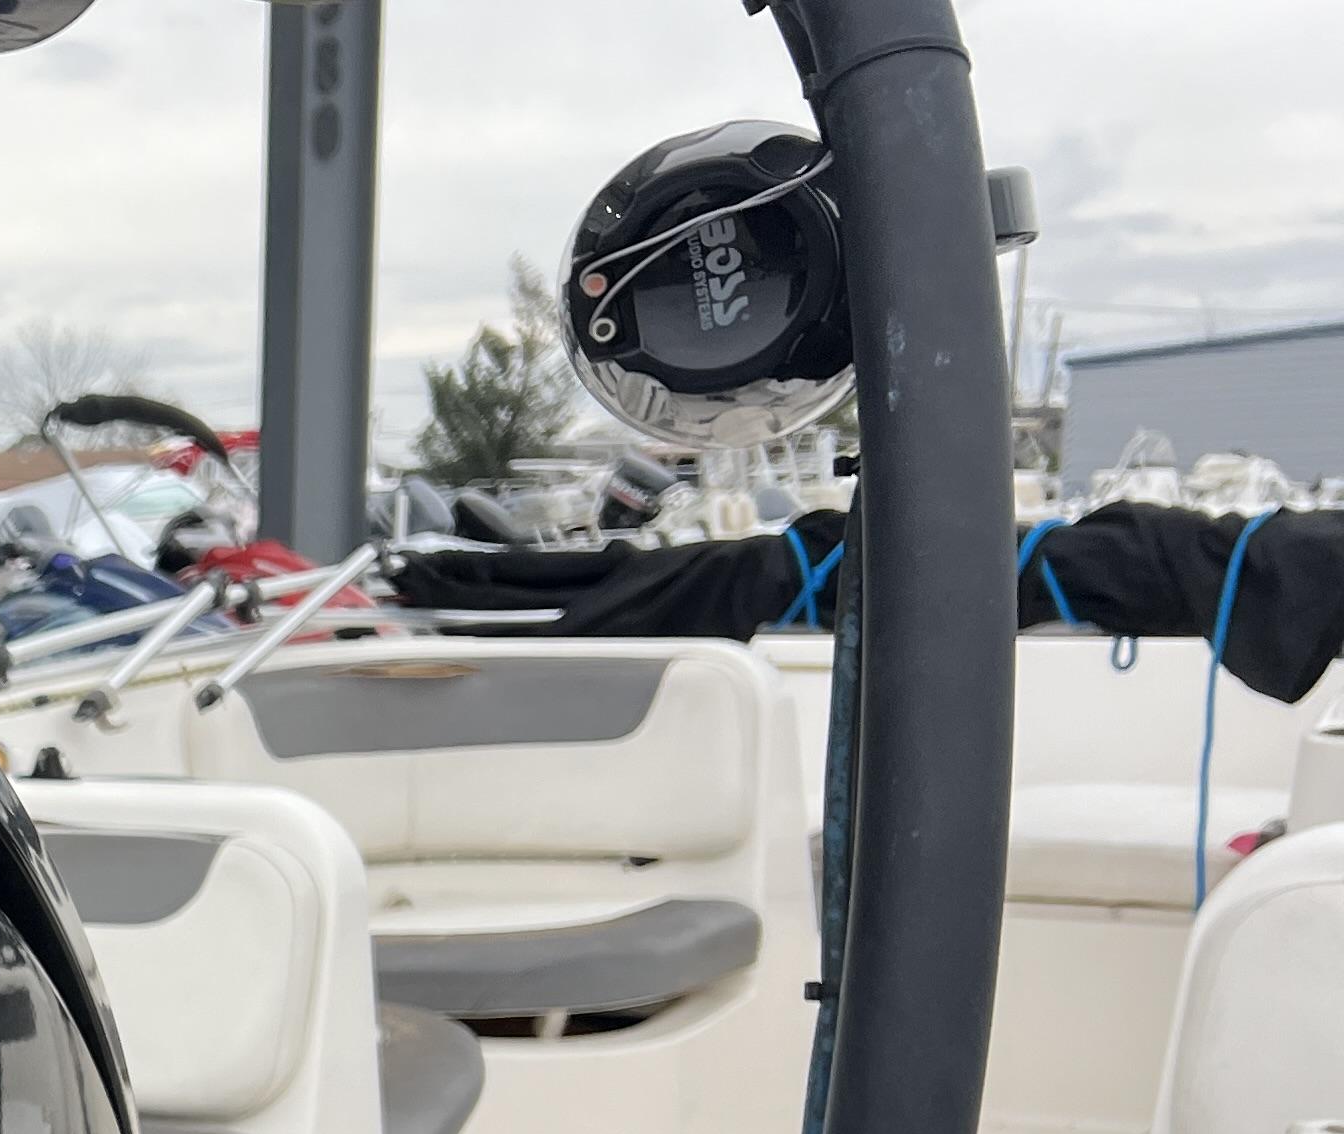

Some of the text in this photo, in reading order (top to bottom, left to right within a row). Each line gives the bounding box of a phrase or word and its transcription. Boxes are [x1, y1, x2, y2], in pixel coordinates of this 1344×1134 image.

[686, 232, 714, 331] UDIO SYSTEMS
[698, 217, 749, 326] BOSS
